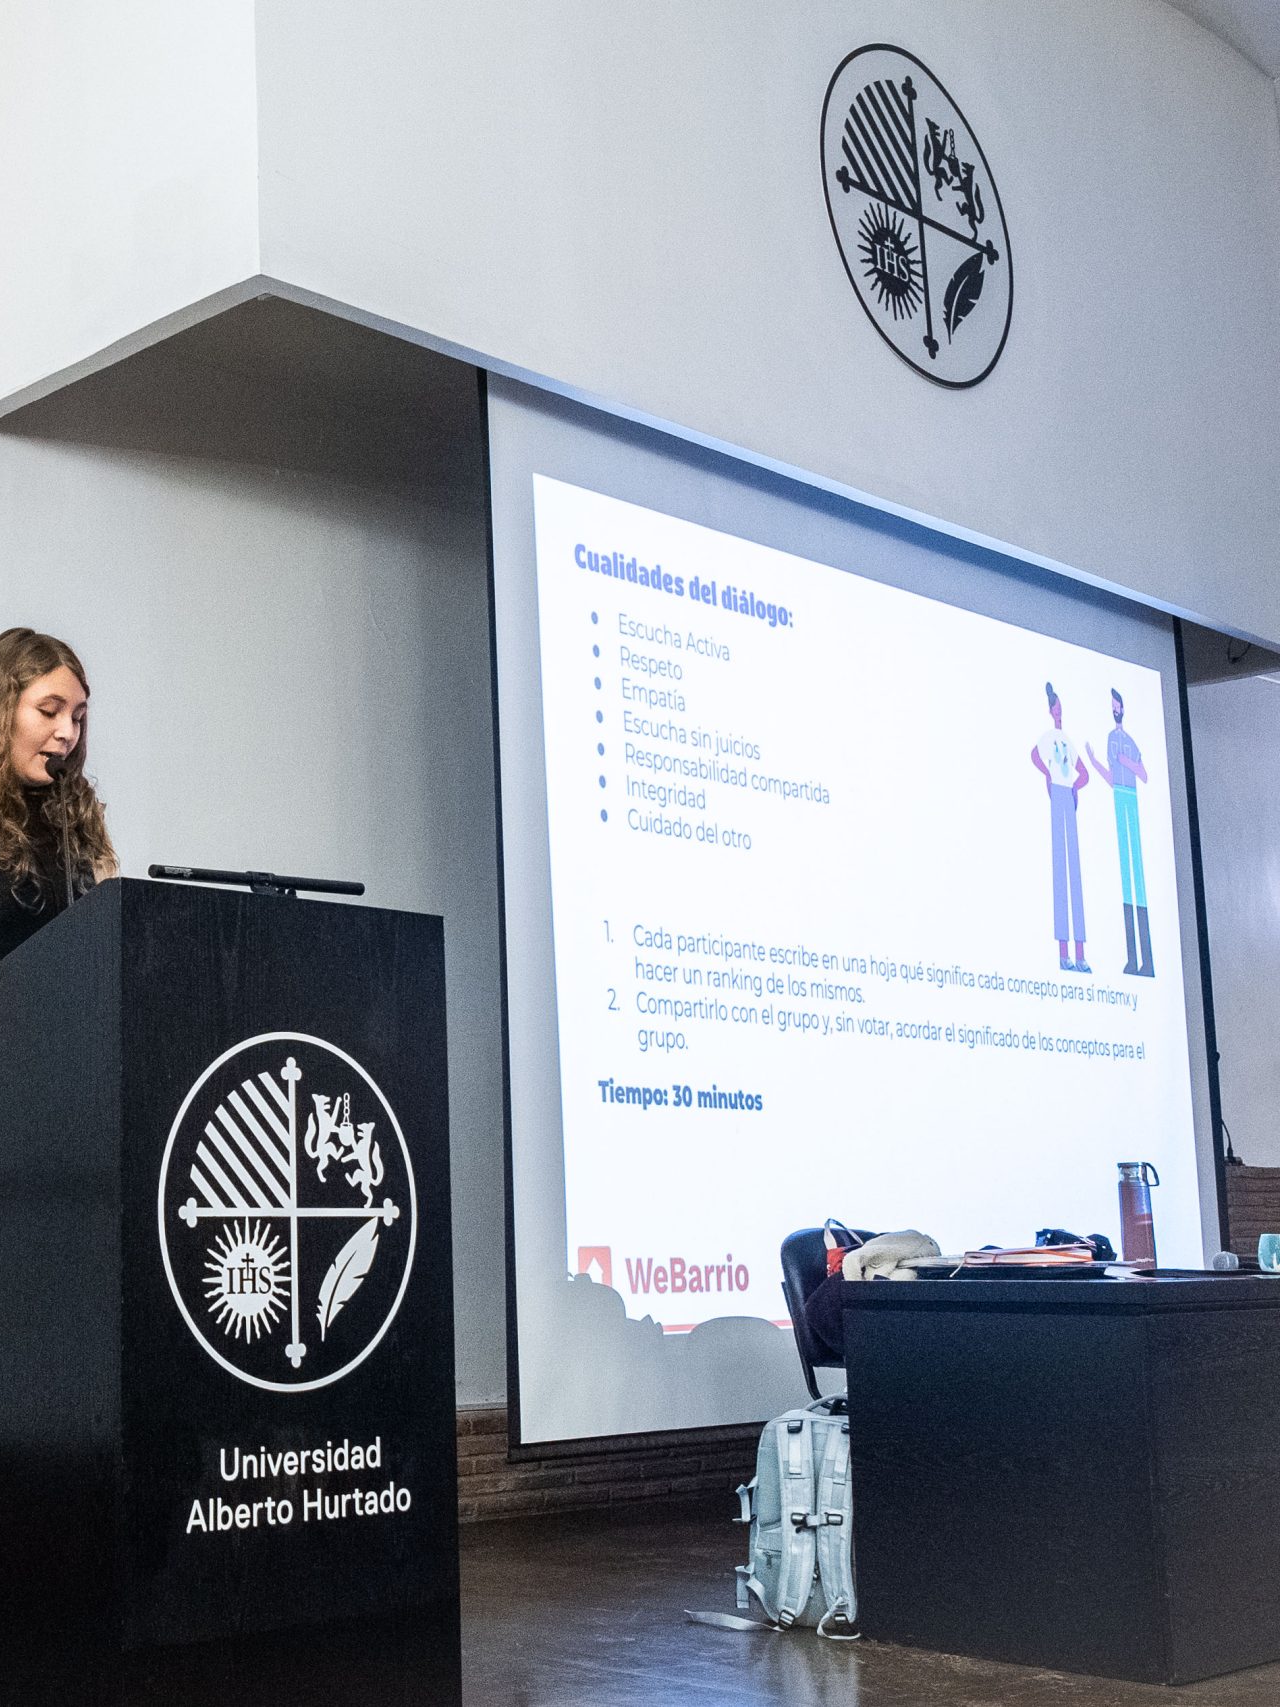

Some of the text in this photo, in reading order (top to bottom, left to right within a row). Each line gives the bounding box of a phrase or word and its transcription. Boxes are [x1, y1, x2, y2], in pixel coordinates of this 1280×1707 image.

[875, 244, 909, 282] IHS
[574, 543, 794, 628] Cualidades del diálogo:
[618, 613, 730, 661] Escucha Activa
[620, 646, 683, 680] Respeto
[621, 677, 686, 712] Empatía
[623, 710, 761, 761] Escucha sin juicios
[625, 742, 830, 804] Responsabilidad compartida
[626, 775, 706, 810] Integridad
[627, 808, 752, 850] Cuidado del otro
[604, 920, 614, 943] 1.
[633, 924, 672, 950] Cada
[677, 933, 766, 962] participante
[769, 945, 819, 968] escribe
[822, 954, 839, 970] en
[842, 957, 867, 974] una
[870, 955, 897, 982] hoja
[900, 961, 924, 984] qué
[926, 963, 975, 988] significa
[977, 972, 1005, 991] cada
[1007, 977, 1058, 1002] concepto
[1061, 985, 1084, 1002] para
[1086, 984, 1095, 1000] sí
[1131, 995, 1138, 1011] y
[635, 956, 866, 1004] hacer un ranking de los mismos.
[607, 988, 1146, 1061] 2. Compartirlo con el grupo y, sin votar, acordar el significado de los conceptos para el
[637, 1028, 689, 1053] grupo.
[598, 1077, 763, 1111] Tiempo: 30 minutos
[226, 1264, 272, 1296] IHS
[624, 1253, 750, 1295] WeBarrio
[219, 1435, 382, 1482] Universidad
[185, 1480, 412, 1534] Alberto Hurtado
